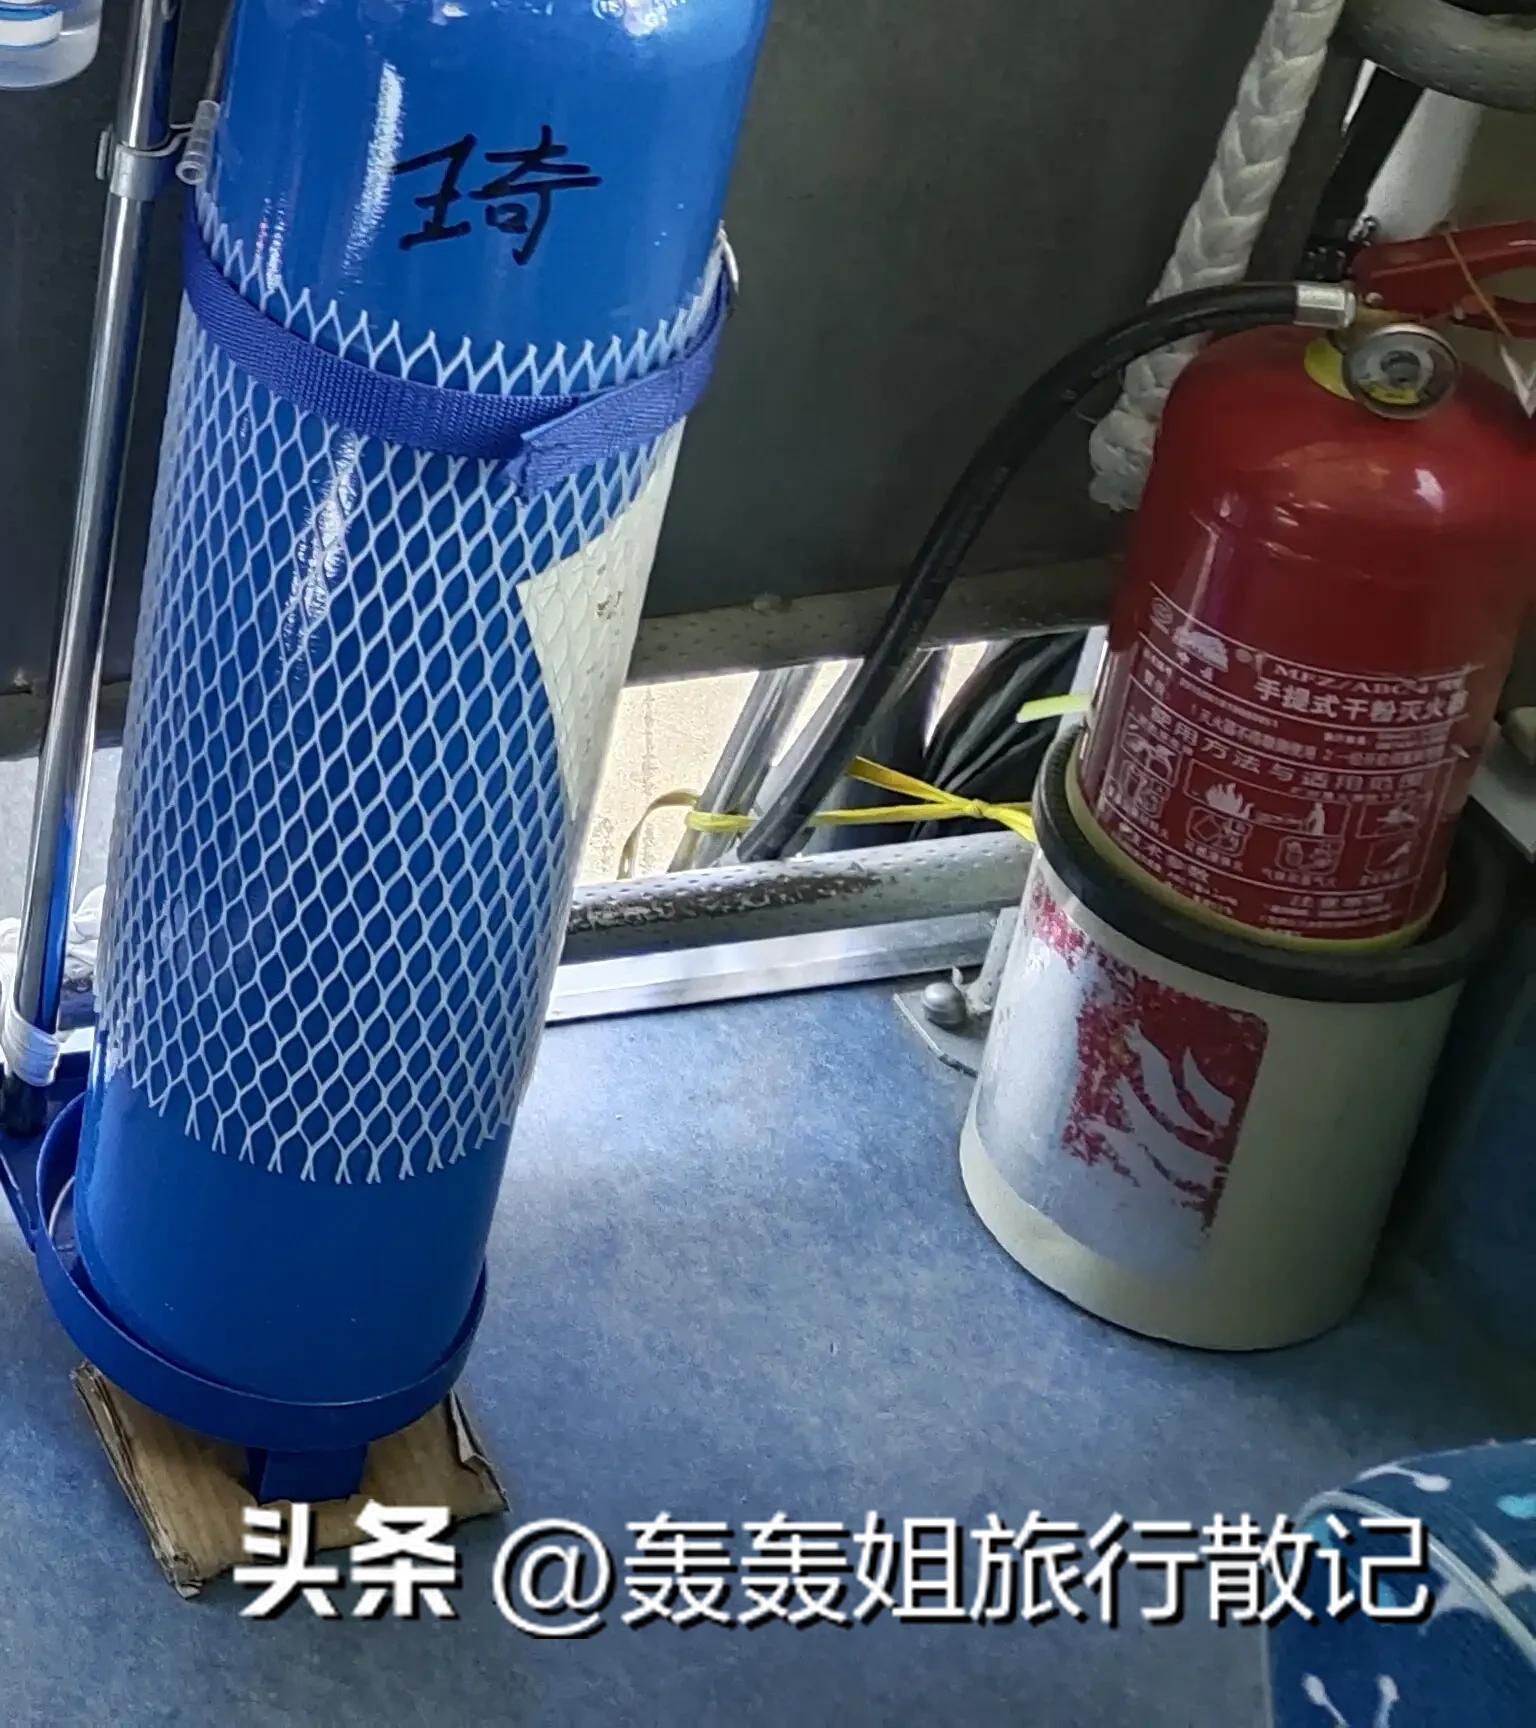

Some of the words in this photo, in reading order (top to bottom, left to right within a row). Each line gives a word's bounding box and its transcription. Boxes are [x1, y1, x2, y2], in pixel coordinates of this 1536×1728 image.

[1254, 676, 1469, 722] 手提式干粉灭火器
